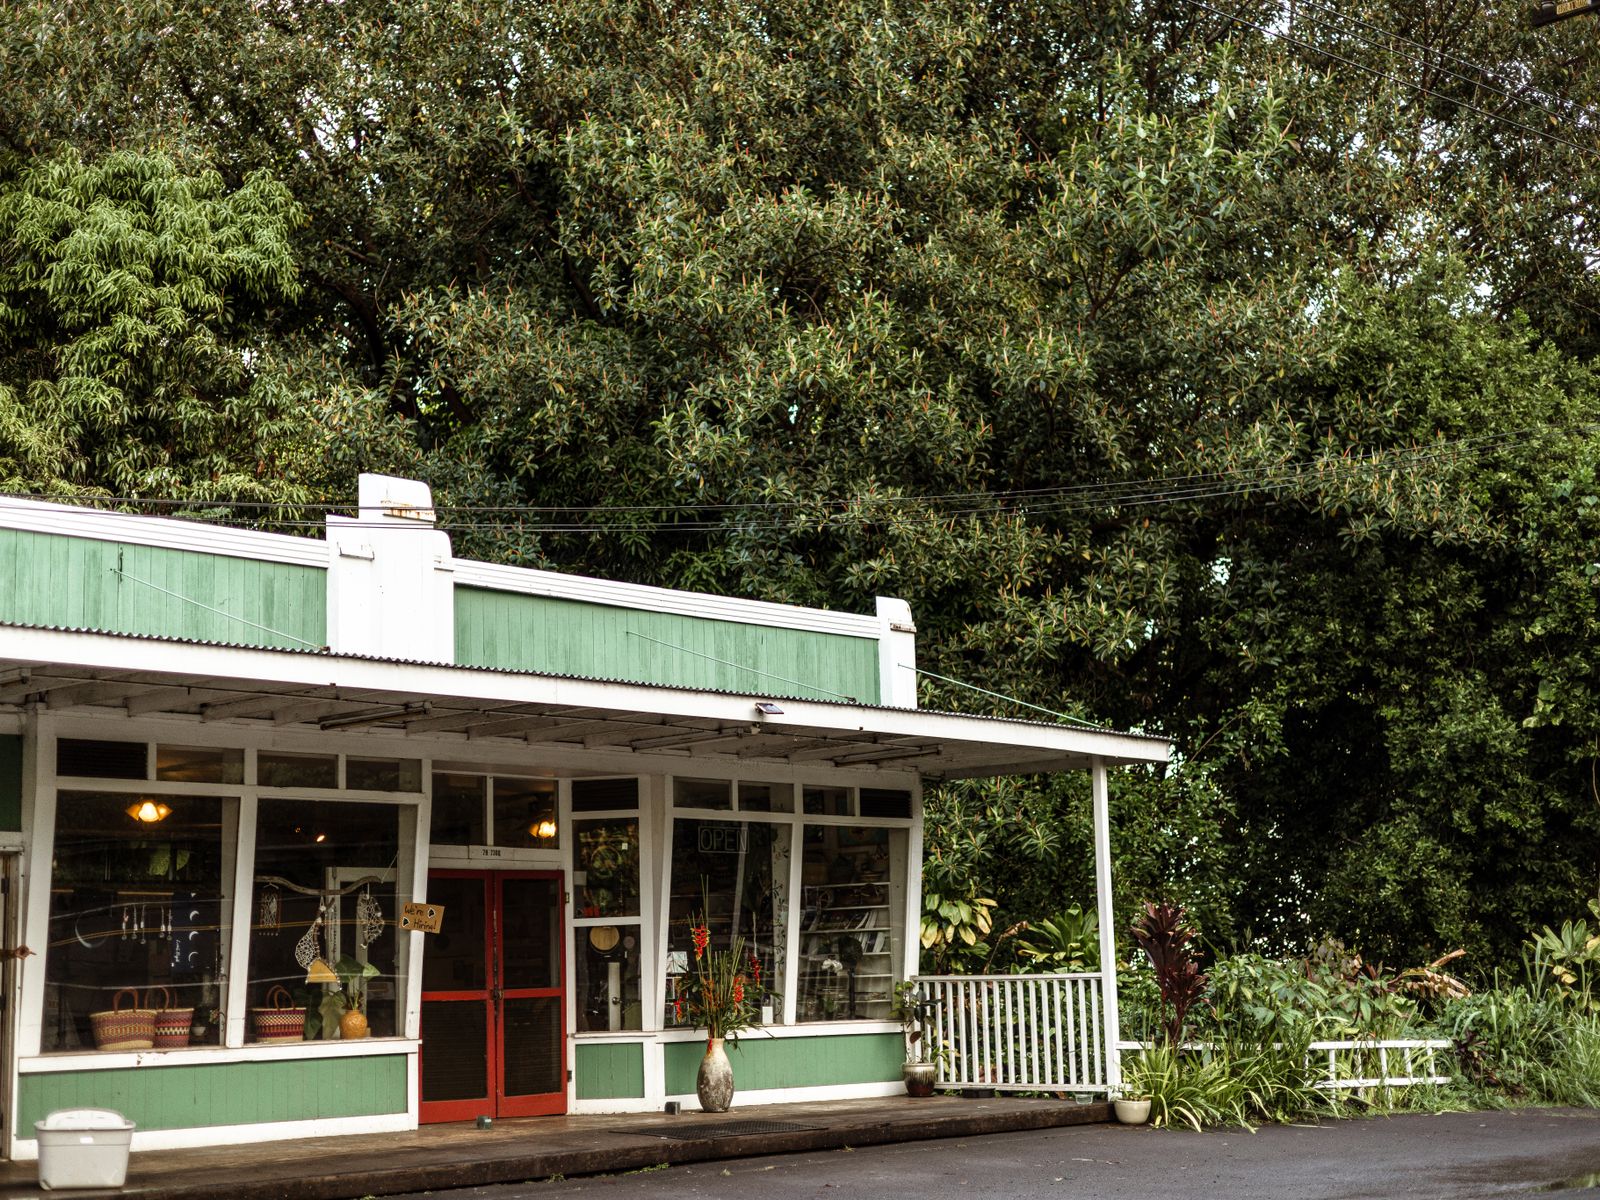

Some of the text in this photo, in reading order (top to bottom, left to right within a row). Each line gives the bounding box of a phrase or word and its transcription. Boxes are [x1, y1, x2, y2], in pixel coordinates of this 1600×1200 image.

[701, 829, 747, 851] OPEN
[404, 904, 424, 916] We're
[413, 919, 437, 931] Hiring!
